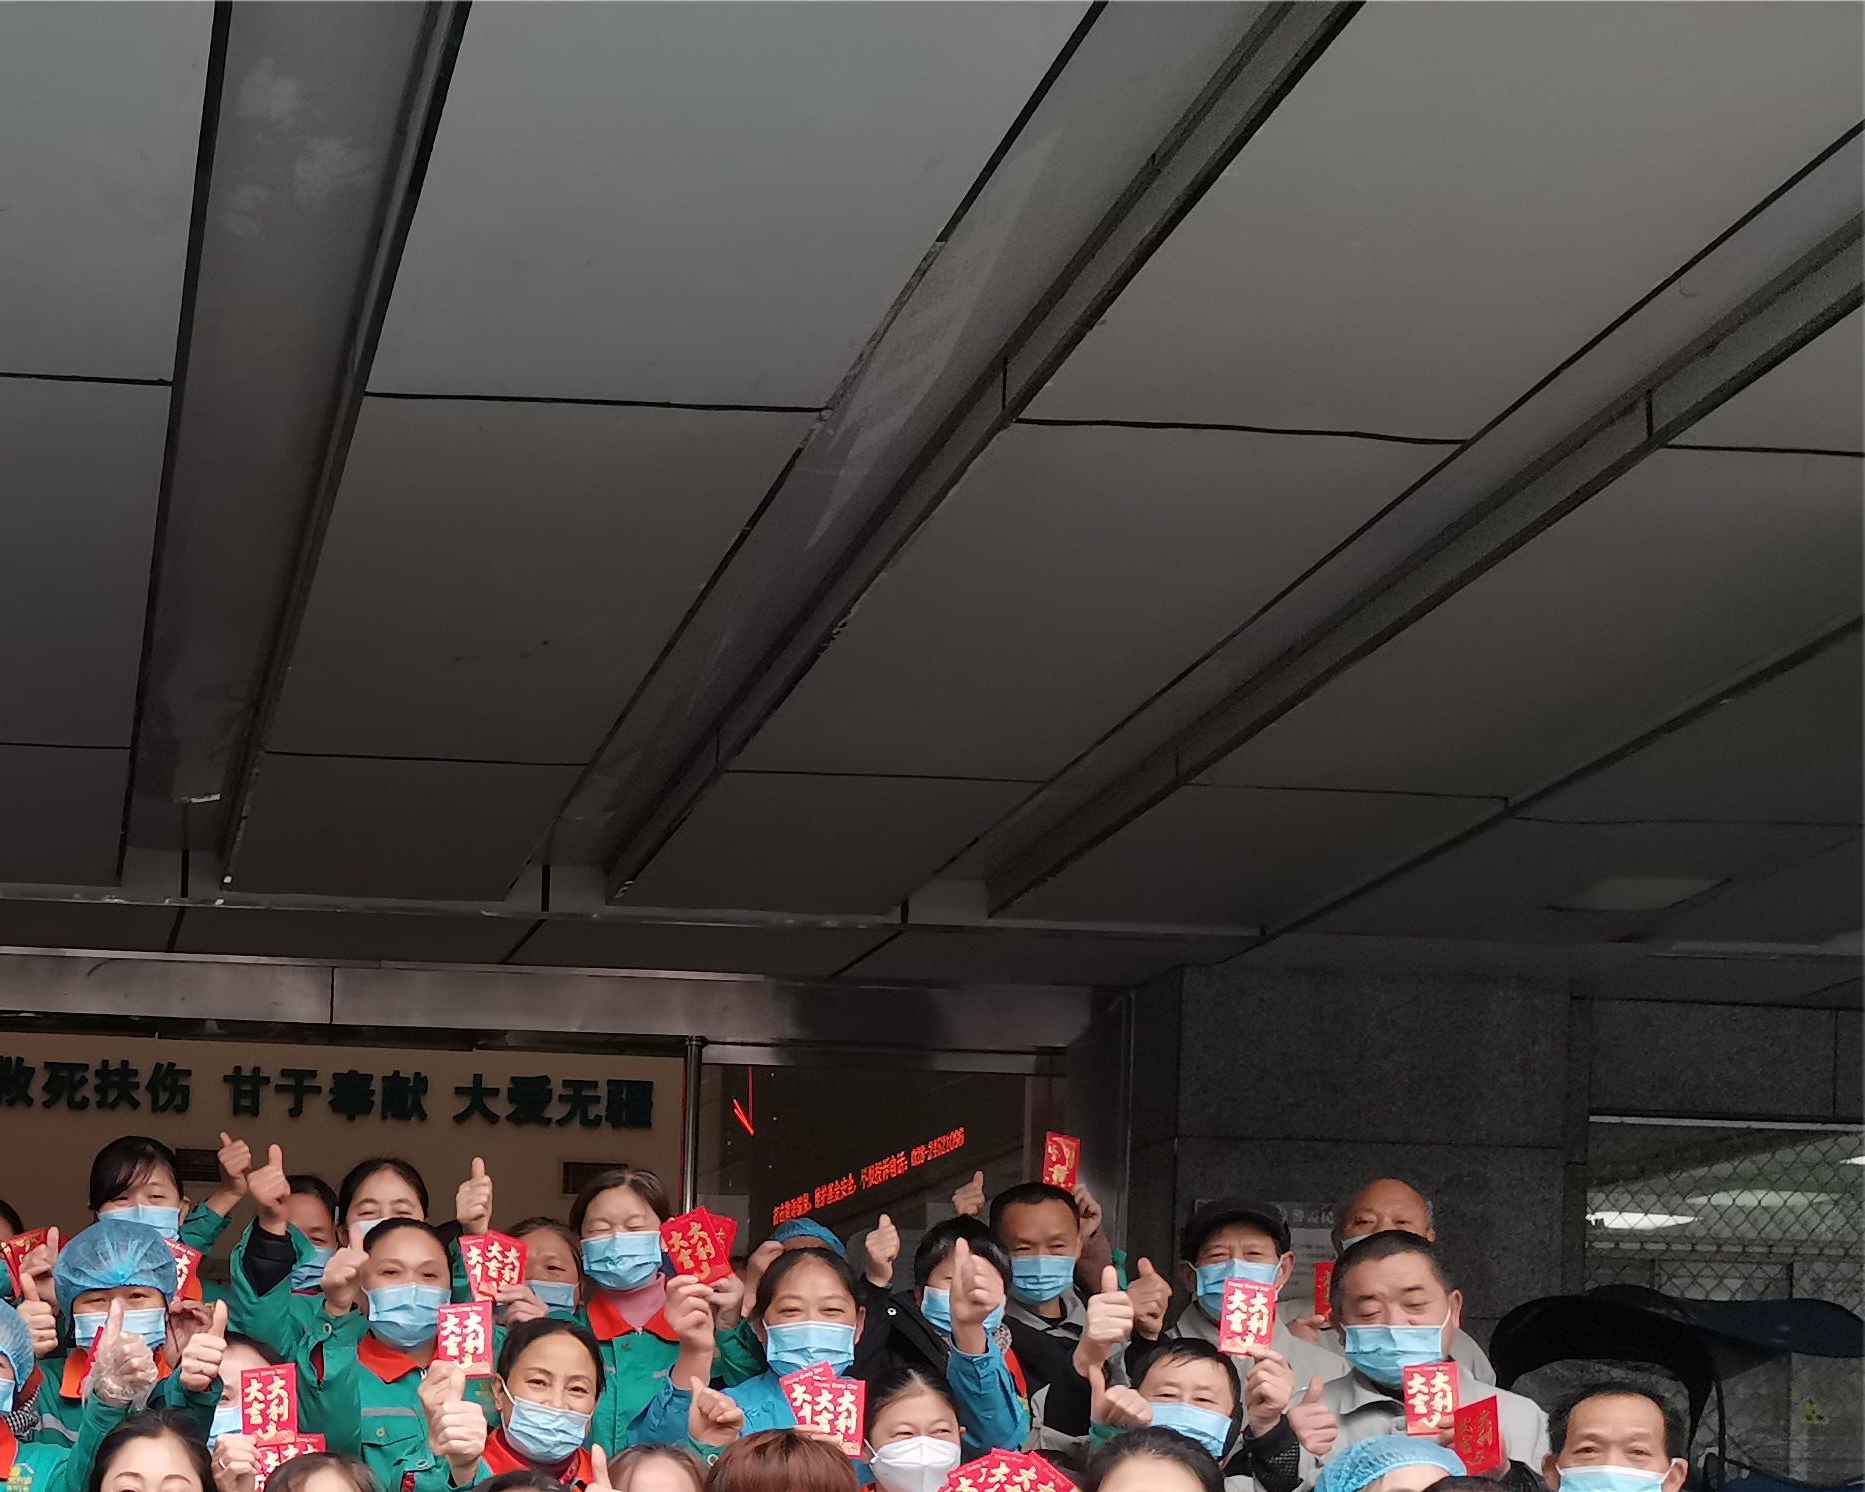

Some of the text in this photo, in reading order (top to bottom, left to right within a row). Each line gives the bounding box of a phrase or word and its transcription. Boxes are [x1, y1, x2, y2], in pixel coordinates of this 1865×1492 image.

[223, 1066, 429, 1121] 甘于奉献
[453, 1074, 654, 1130] 大爱无疆
